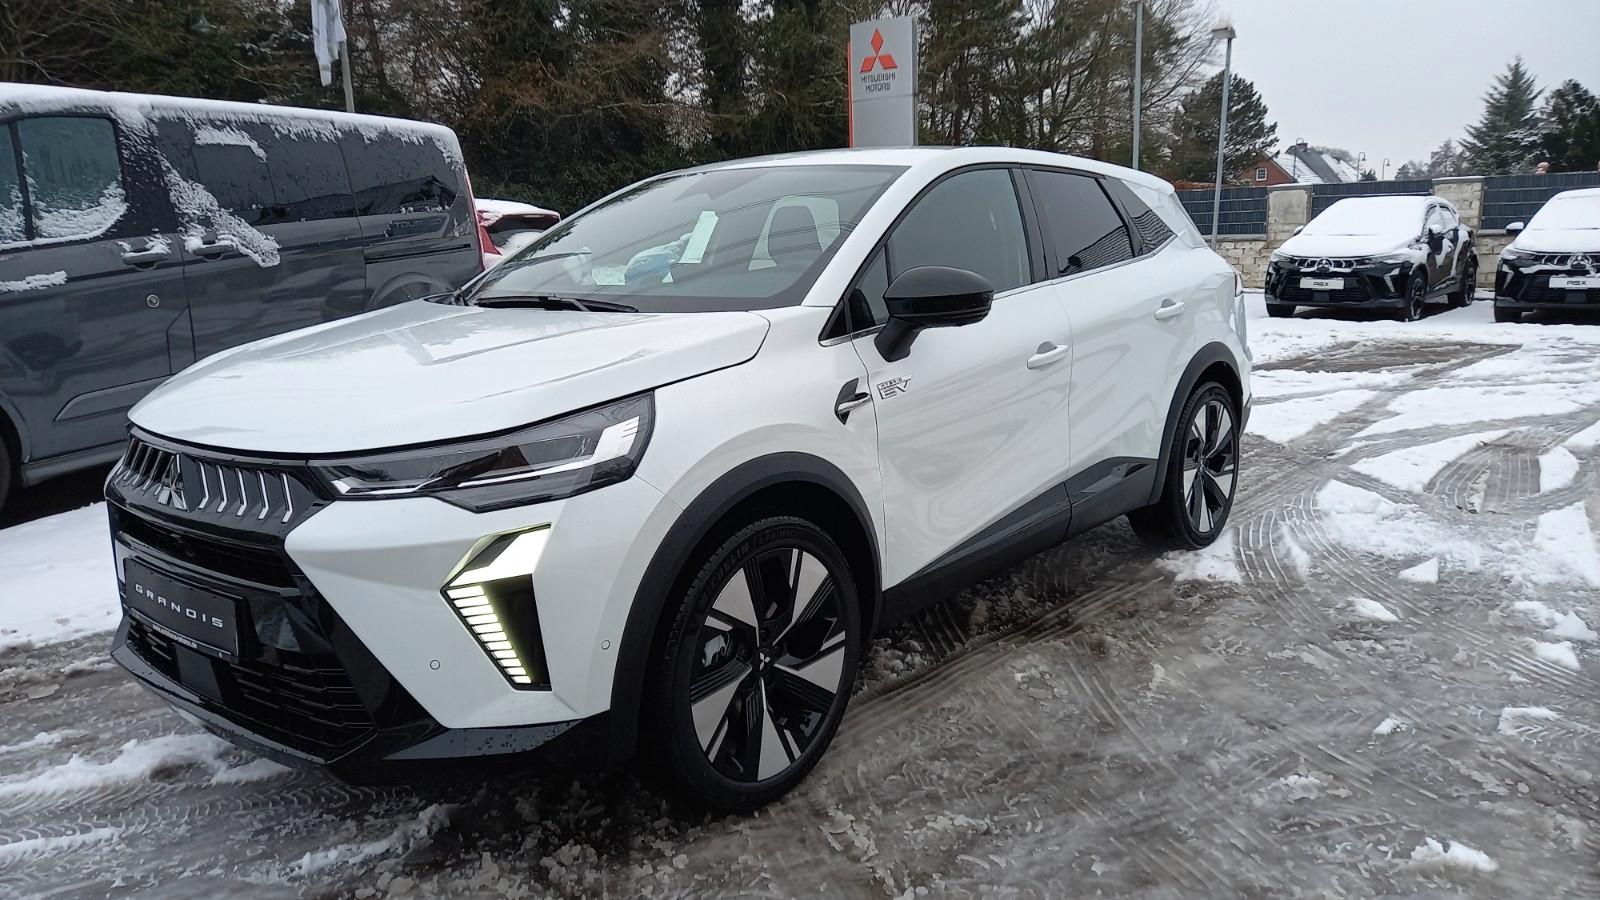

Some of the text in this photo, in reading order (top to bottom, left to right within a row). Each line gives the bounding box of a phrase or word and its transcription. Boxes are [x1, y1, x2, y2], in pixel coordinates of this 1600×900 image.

[861, 72, 896, 83] MITSUBISHI
[865, 82, 891, 93] MOTORS
[135, 583, 223, 628] GRANDIS
